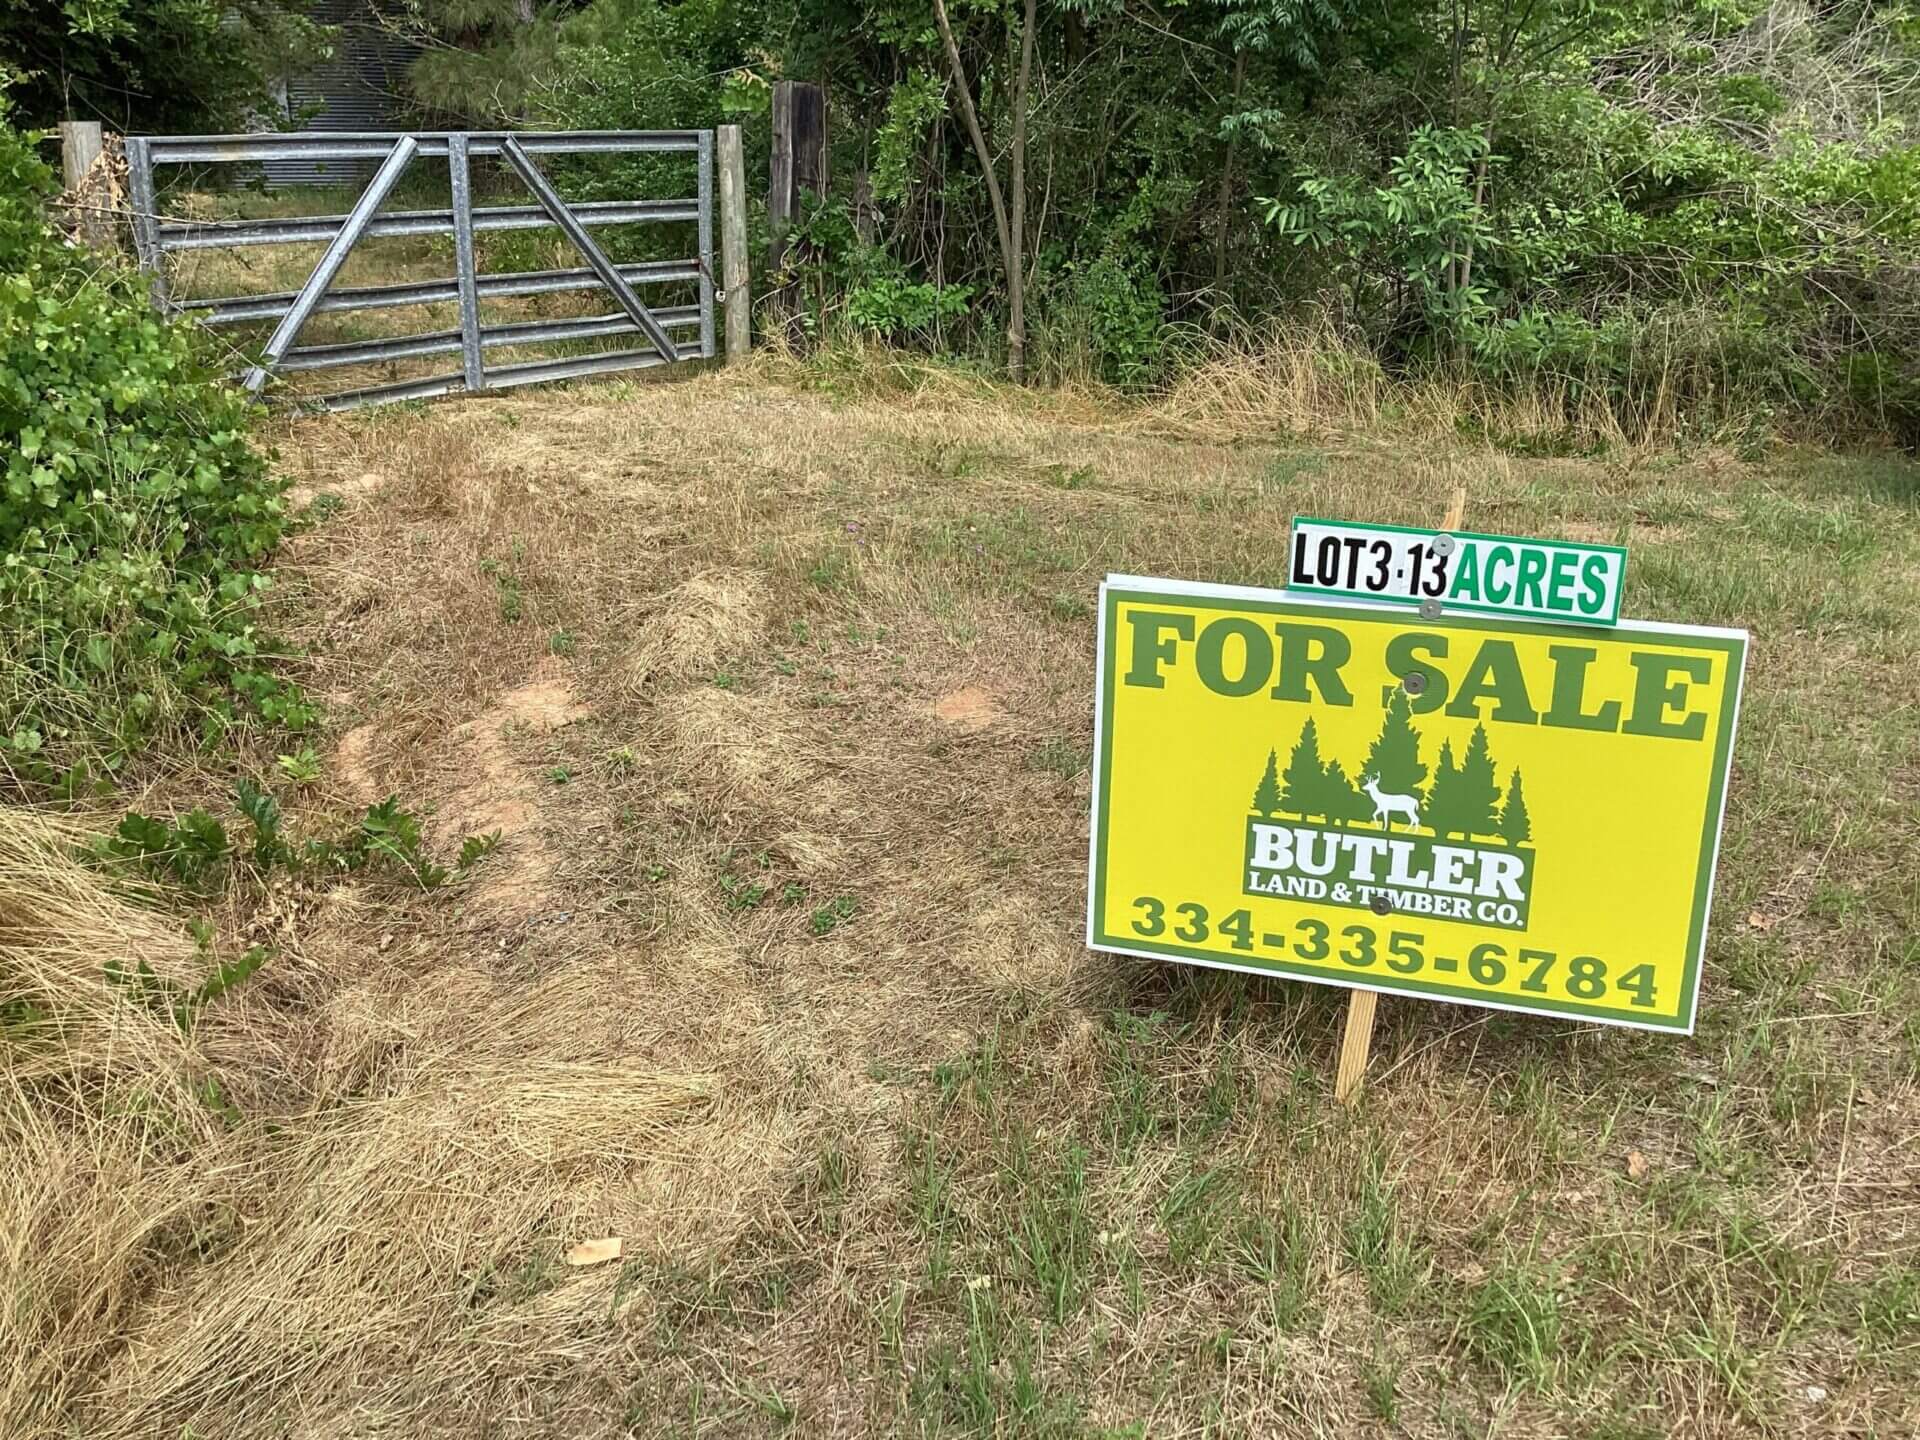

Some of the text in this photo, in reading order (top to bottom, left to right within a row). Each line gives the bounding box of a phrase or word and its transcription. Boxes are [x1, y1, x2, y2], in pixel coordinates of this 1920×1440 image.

[1449, 543, 1609, 615] ACRES
[1124, 610, 1712, 741] FOR SALE
[1248, 871, 1327, 899] LAND
[1330, 882, 1352, 903] &
[1476, 901, 1524, 926] CO.
[1250, 823, 1525, 900] BUTLER
[1131, 896, 1657, 1007] 334-335-6784
